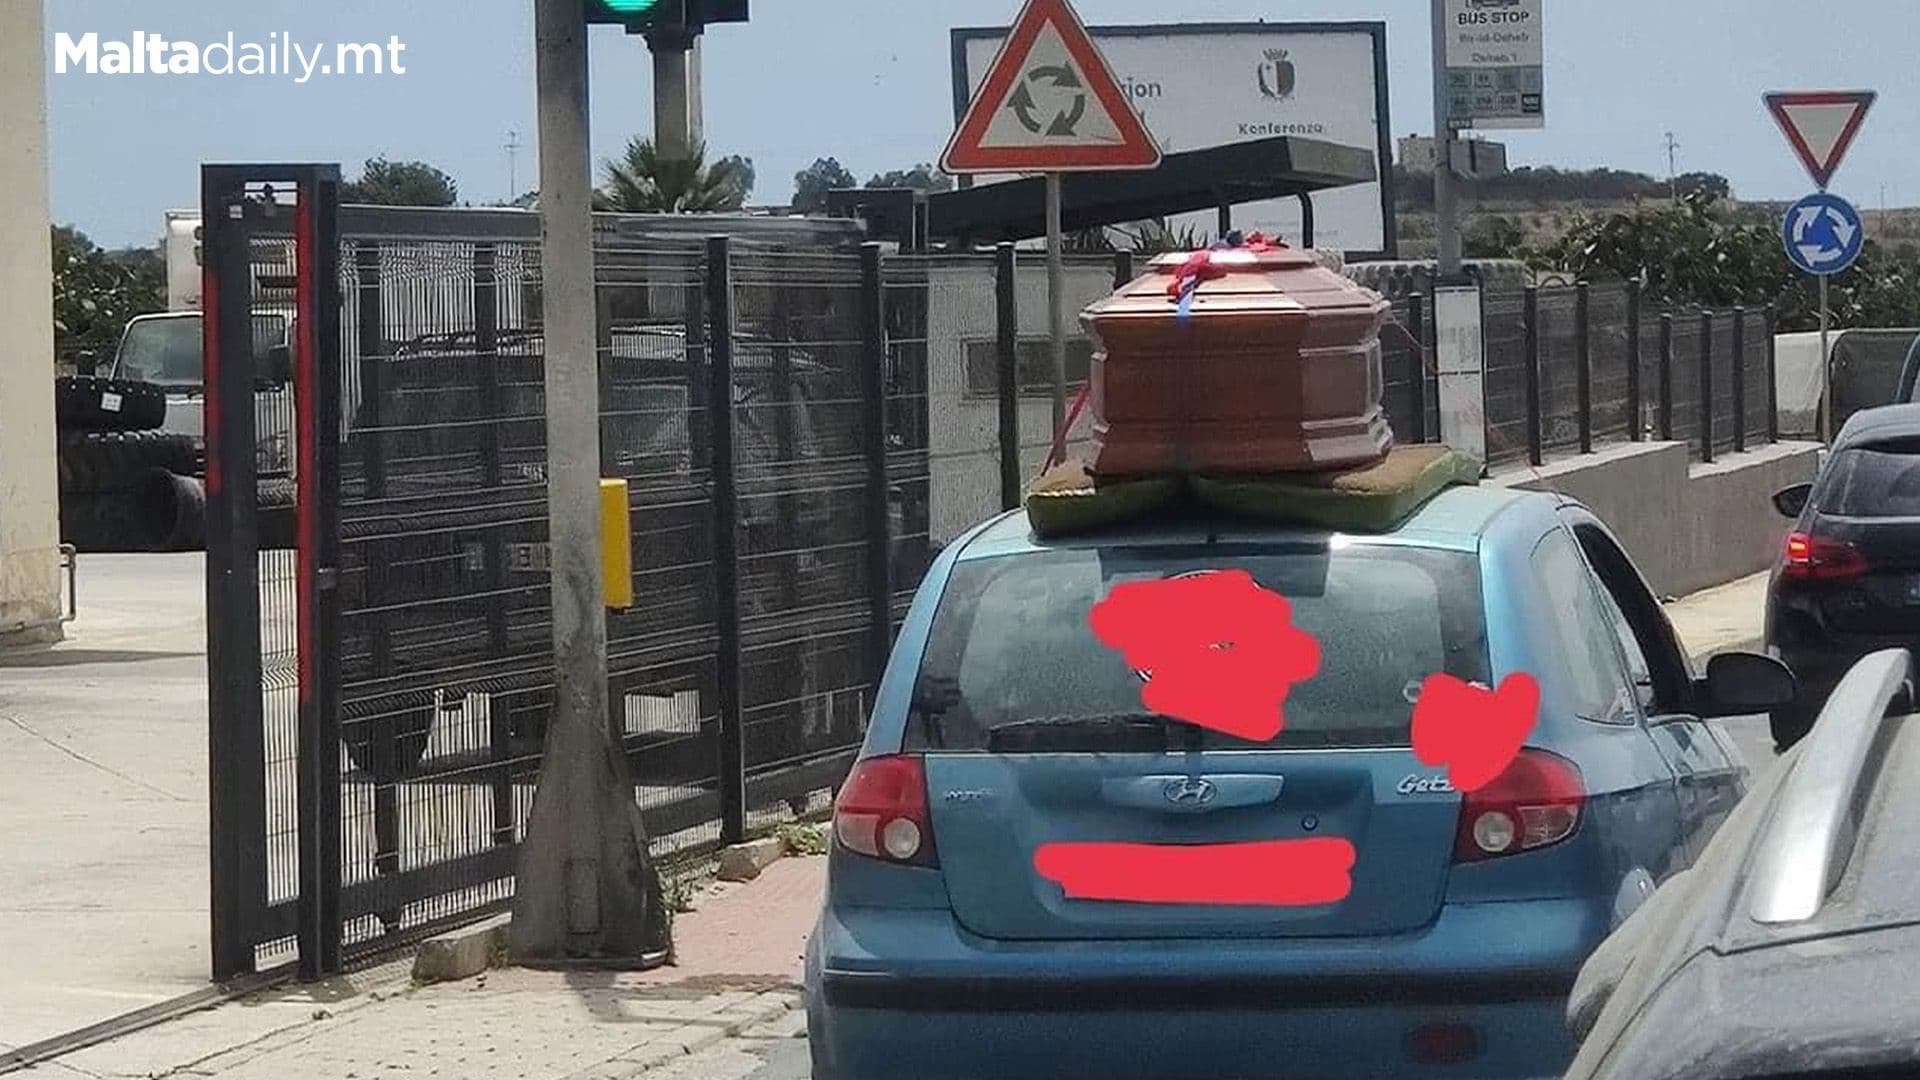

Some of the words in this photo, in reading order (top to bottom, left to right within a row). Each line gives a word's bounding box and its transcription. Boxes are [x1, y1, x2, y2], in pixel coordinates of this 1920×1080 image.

[1458, 11, 1488, 25] BUS
[1491, 11, 1529, 24] STOP
[1396, 774, 1456, 794] Getz
